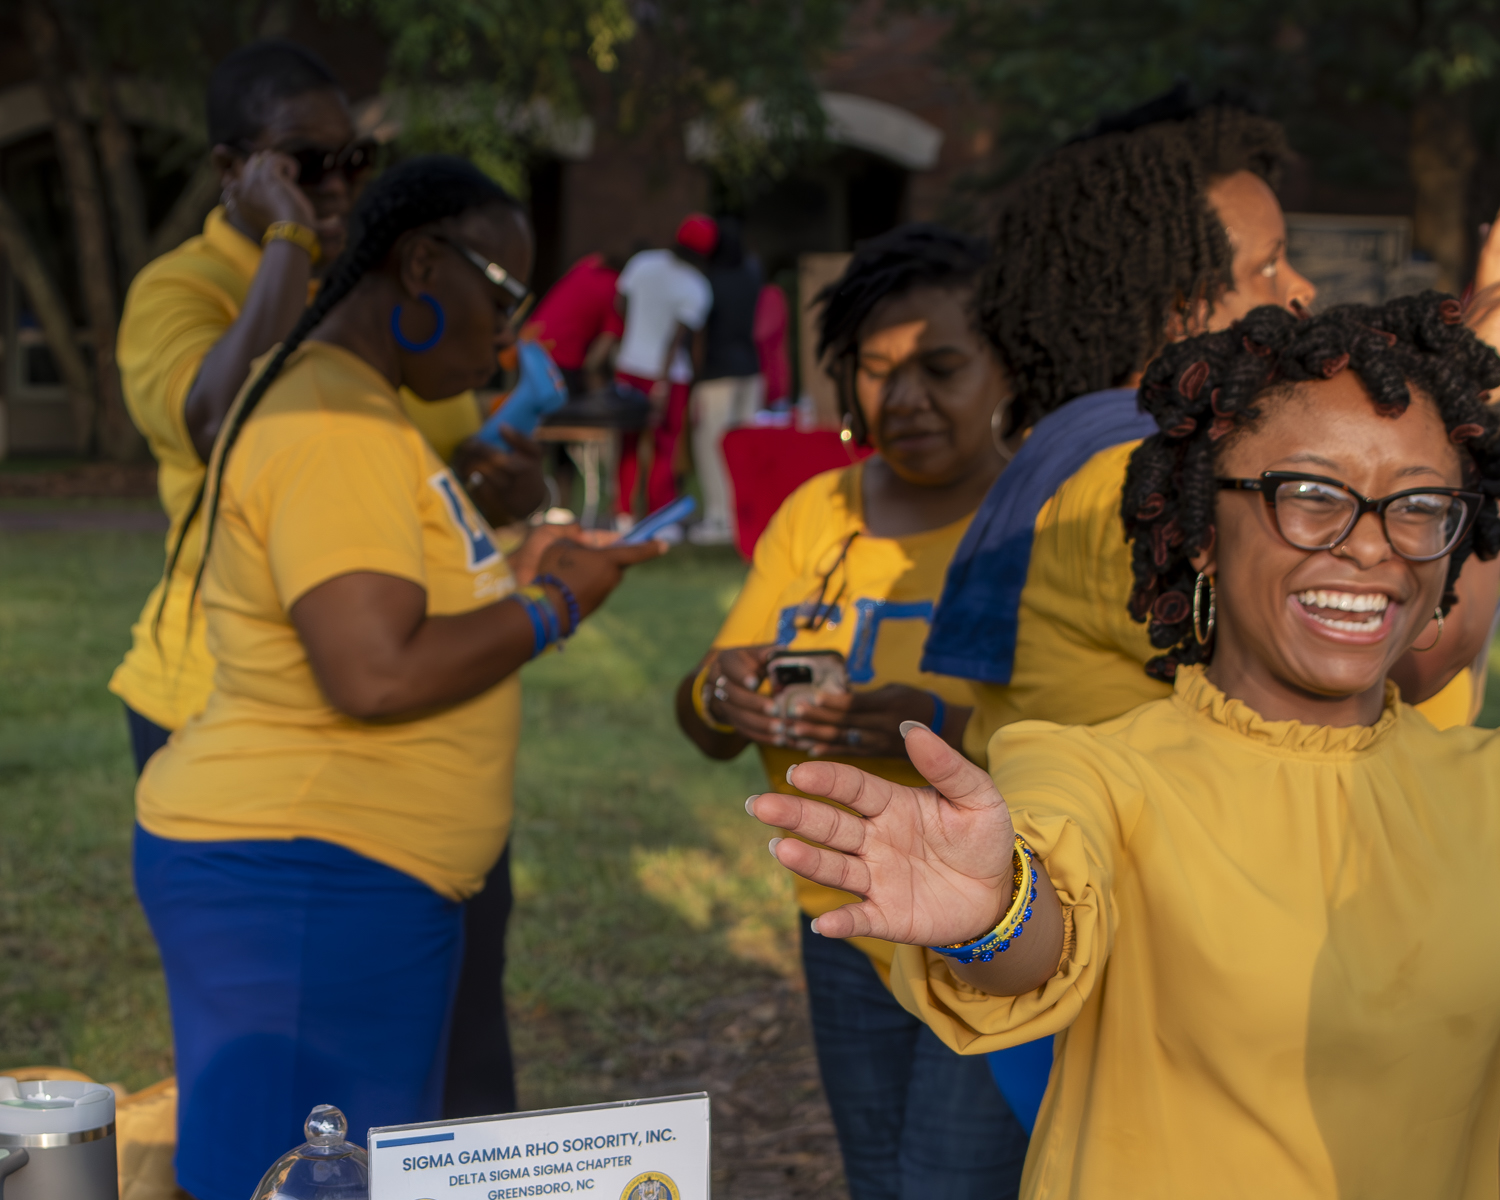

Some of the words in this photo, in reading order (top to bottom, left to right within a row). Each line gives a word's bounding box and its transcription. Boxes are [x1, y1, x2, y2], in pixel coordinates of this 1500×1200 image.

[402, 1152, 455, 1172] SIGMA
[458, 1145, 522, 1165] GAMMA
[525, 1141, 559, 1157] RHO
[562, 1131, 642, 1153] SORORITY,
[645, 1128, 677, 1144] INC.
[449, 1172, 487, 1187] DELTA
[489, 1166, 531, 1182] SIGMA
[533, 1162, 574, 1178] SIGMA
[576, 1155, 632, 1172] CHAPTER
[488, 1181, 574, 1200] GREENSBORO,
[577, 1178, 595, 1191] NC
